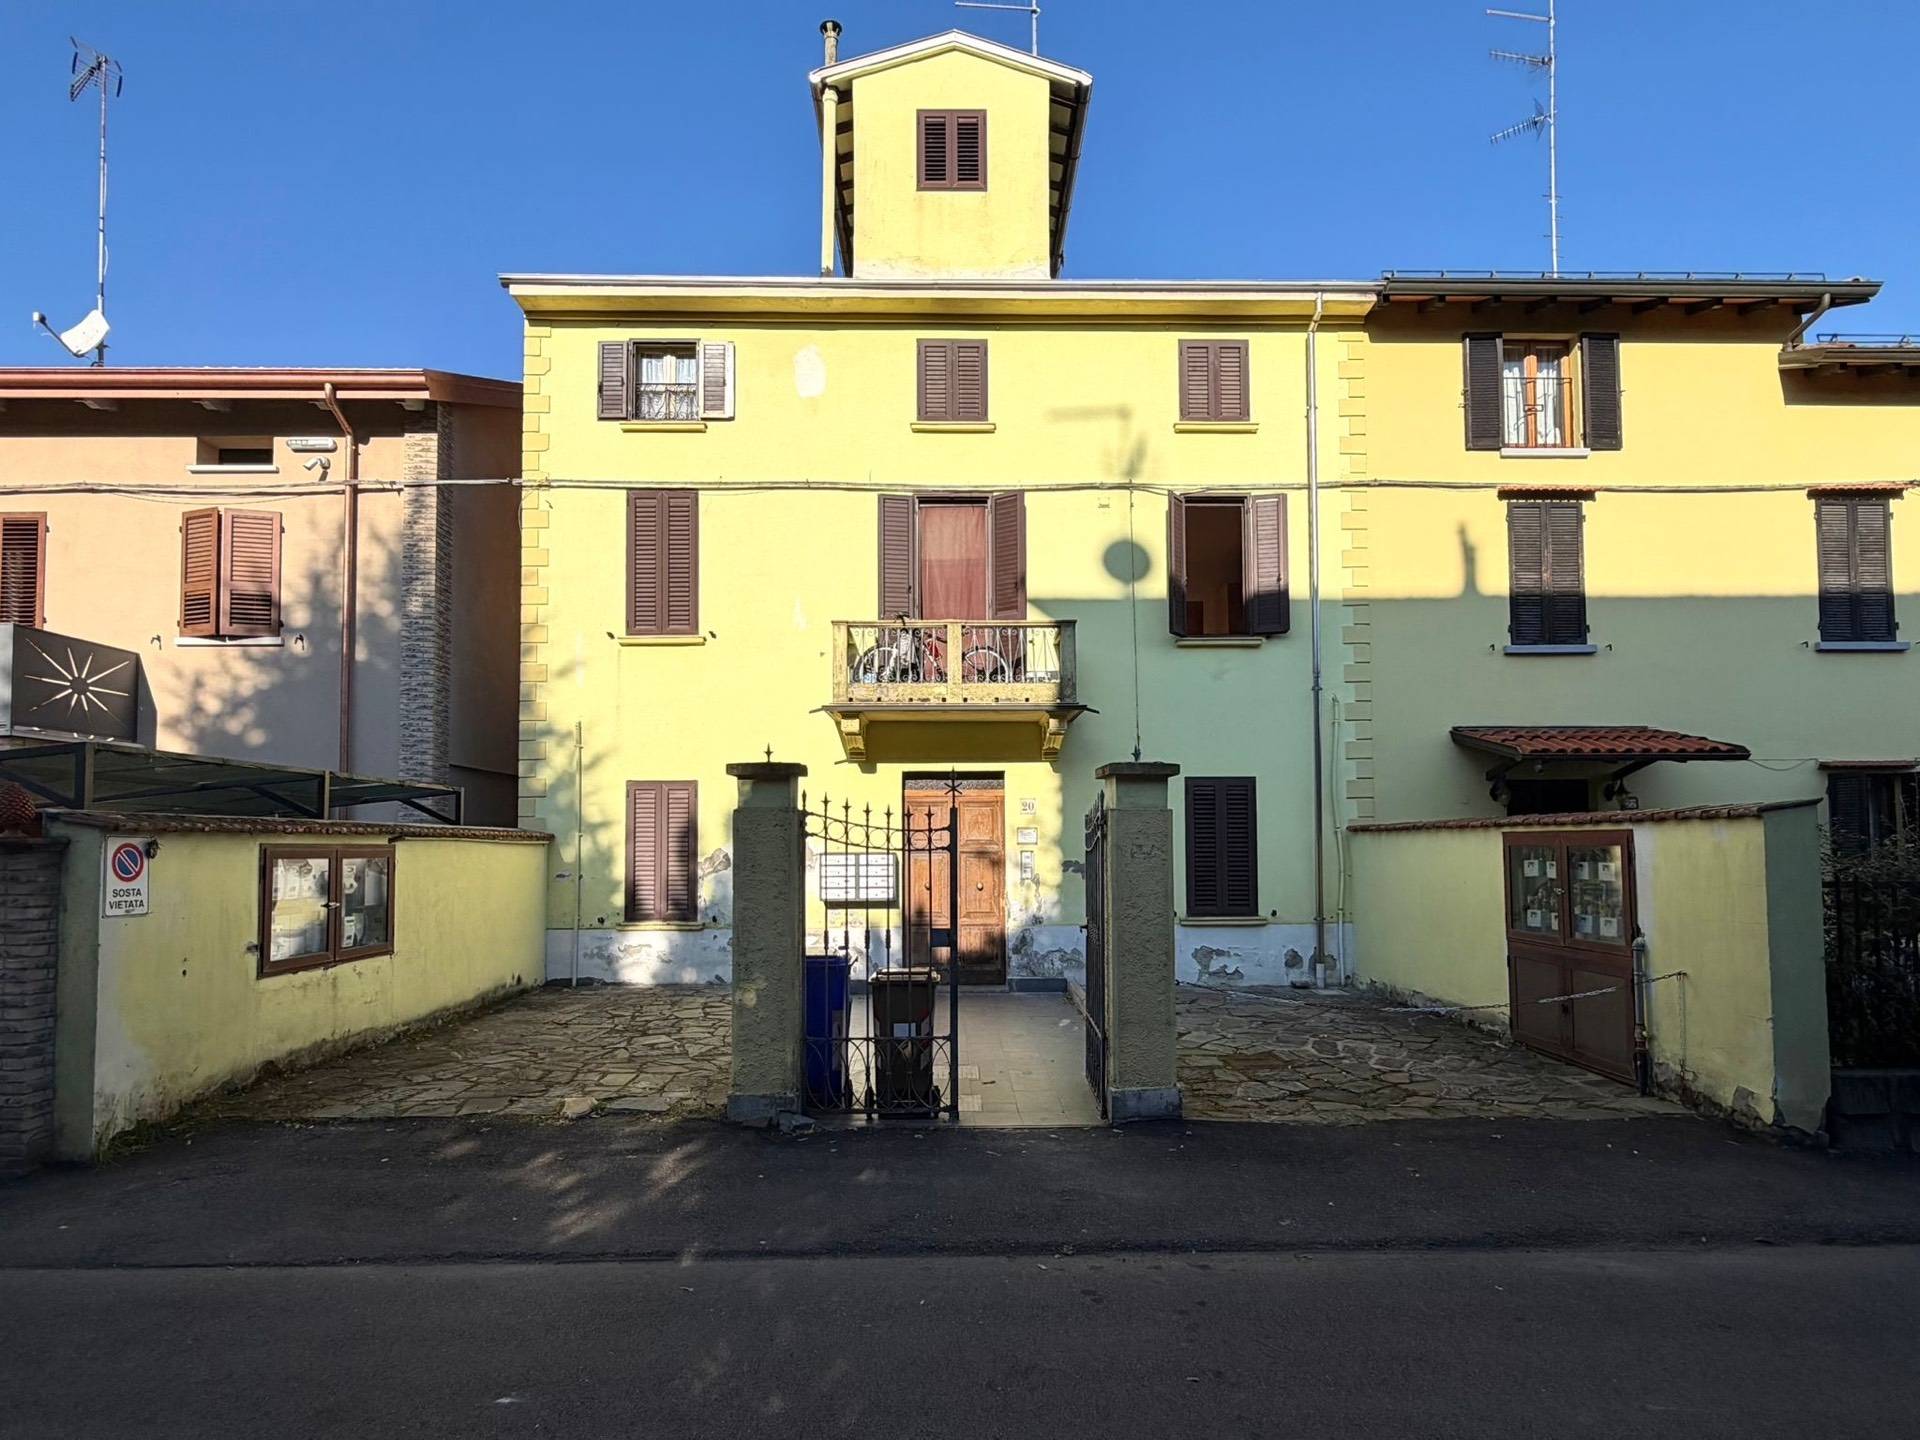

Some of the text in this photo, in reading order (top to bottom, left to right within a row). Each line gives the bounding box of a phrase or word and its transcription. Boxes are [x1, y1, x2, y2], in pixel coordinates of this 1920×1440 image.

[1021, 801, 1035, 812] 20
[112, 888, 142, 898] SOSTA
[109, 899, 145, 910] VIETATA
